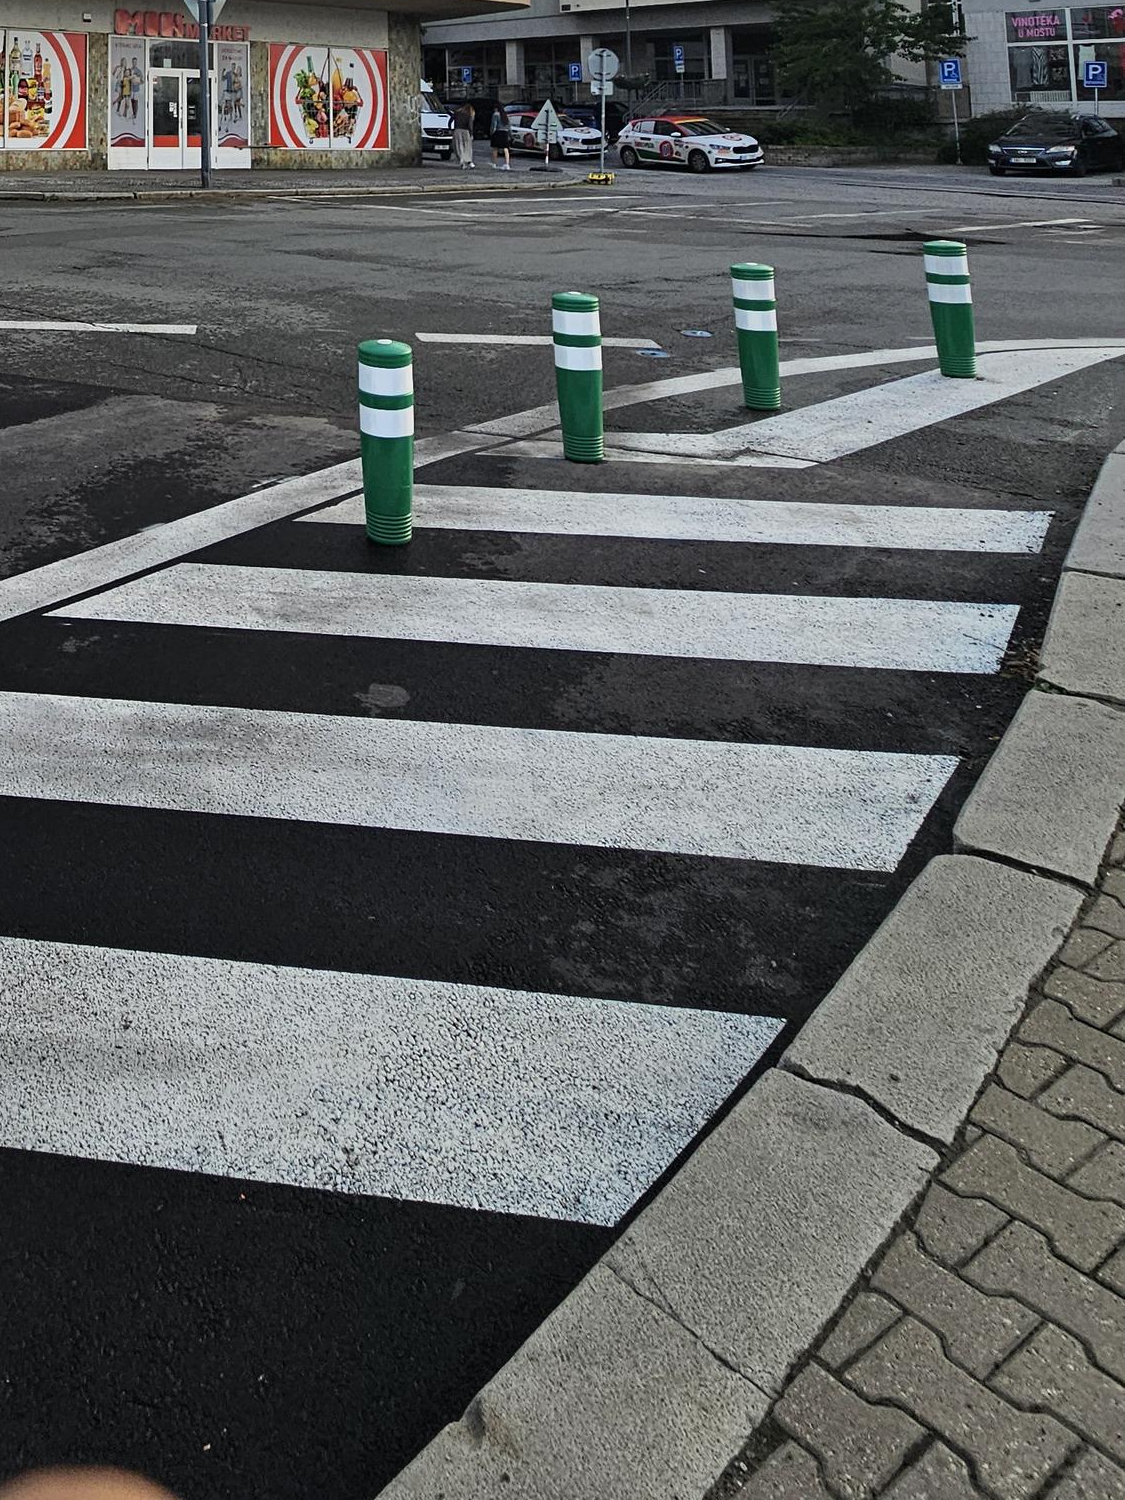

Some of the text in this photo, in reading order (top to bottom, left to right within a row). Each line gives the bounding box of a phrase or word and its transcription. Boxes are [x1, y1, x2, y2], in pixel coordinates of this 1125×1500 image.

[1011, 15, 1060, 27] VINOTÉKA
[1018, 28, 1056, 38] U MOSTU
[571, 65, 579, 75] P
[944, 62, 956, 76] P
[1089, 64, 1102, 79] P
